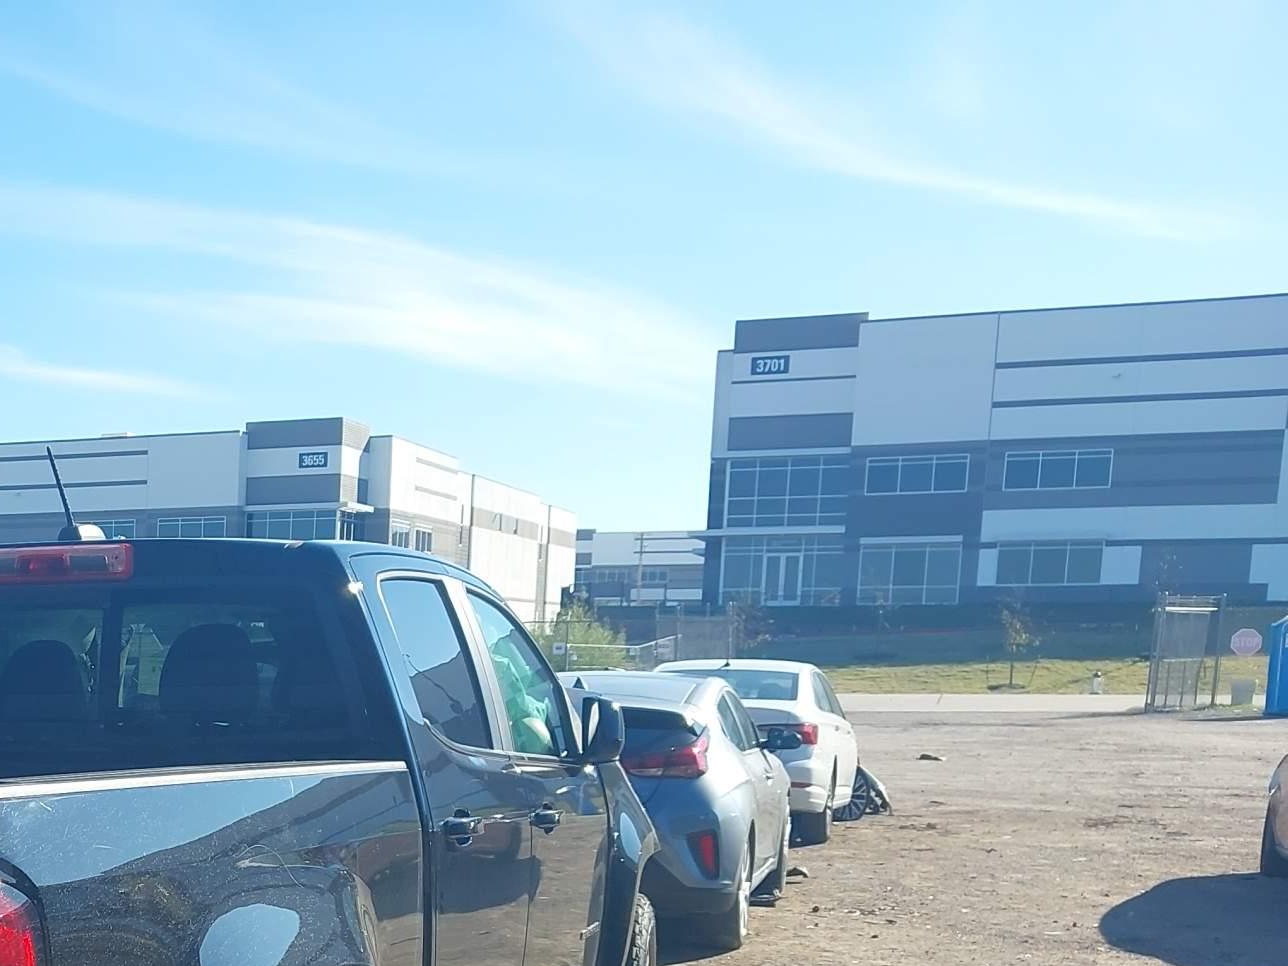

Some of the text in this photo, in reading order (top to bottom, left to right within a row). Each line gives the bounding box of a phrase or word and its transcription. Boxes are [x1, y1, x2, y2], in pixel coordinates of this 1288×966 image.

[756, 358, 785, 373] 3701
[302, 454, 325, 467] 3655
[1233, 636, 1261, 648] STOP
